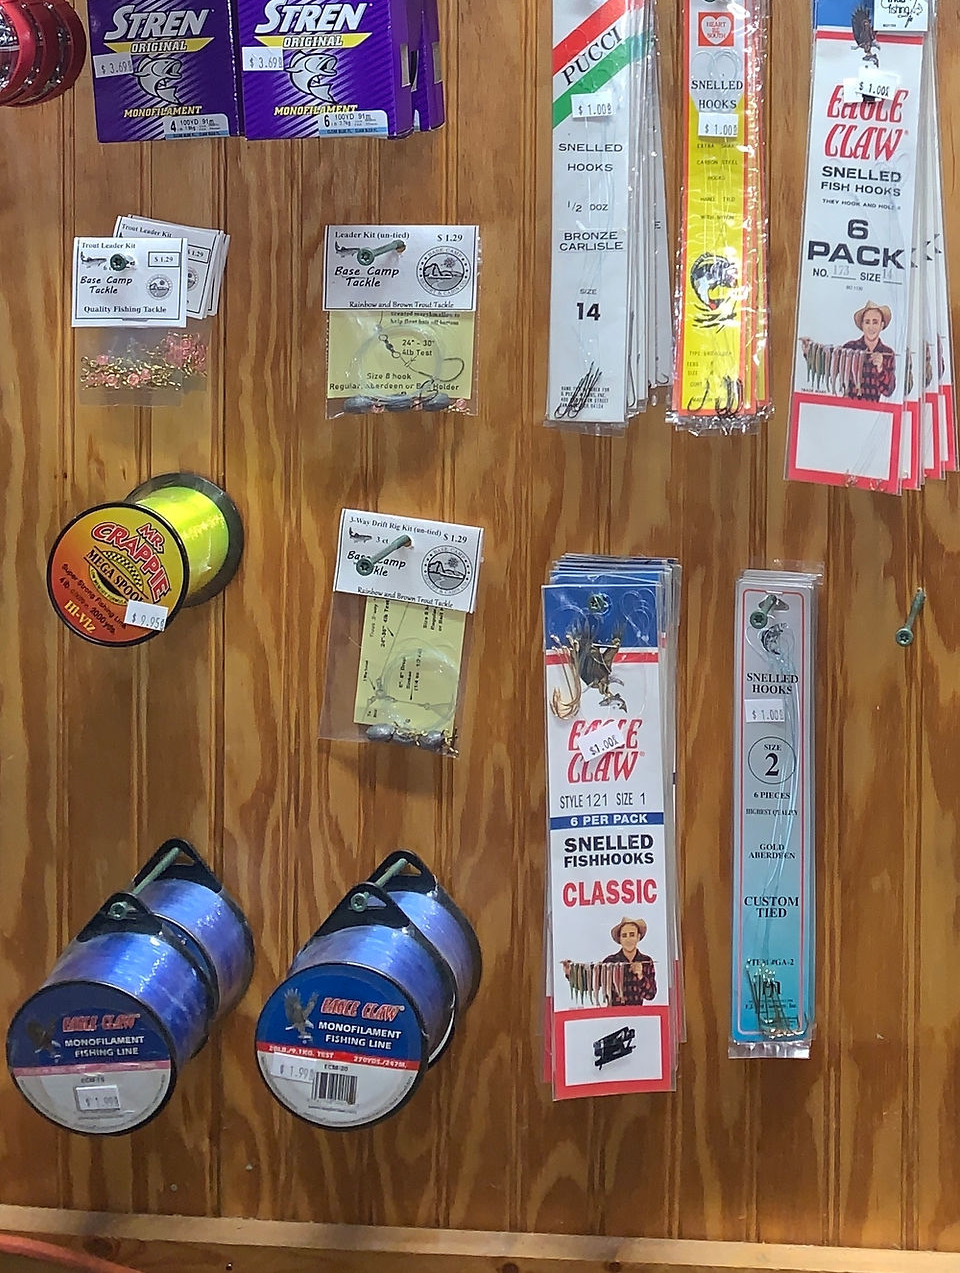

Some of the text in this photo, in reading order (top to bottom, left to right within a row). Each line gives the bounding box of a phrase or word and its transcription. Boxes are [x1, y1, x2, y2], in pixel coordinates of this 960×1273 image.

[282, 35, 343, 49] ORIGINAL
[560, 27, 624, 86] PUCCI
[558, 143, 623, 153] SNELLED
[824, 127, 902, 160] CLAW
[567, 162, 614, 172] HOOKS
[822, 166, 902, 182] SNELLED
[820, 182, 901, 197] FISH HOOKS
[335, 231, 361, 239] Leader
[362, 231, 374, 239] Kit
[563, 230, 618, 241] BRONZE
[846, 218, 869, 240] 6
[445, 234, 463, 242] 1.29
[559, 240, 624, 251] CARLISLE
[807, 241, 905, 269] PACK
[334, 266, 399, 279] Base Camp
[860, 272, 882, 283] SIZE
[345, 277, 381, 287] Tackle
[84, 306, 111, 314] Quality
[112, 306, 140, 314] Fishing
[575, 303, 601, 321] 14
[90, 521, 172, 605] CRAPPIE
[86, 549, 144, 602] MEGA SPOO
[746, 672, 799, 684] SNELLED
[751, 684, 793, 695] HOOKS
[567, 752, 638, 784] CLAW
[764, 754, 780, 778] 2
[560, 792, 633, 809] STYLE 121 SIZE
[570, 814, 648, 826] 6 PER PACK
[563, 835, 655, 852] SNELLED
[563, 851, 655, 867] FISHHOOKS
[561, 879, 658, 908] CLASSIC
[744, 896, 800, 908] CUSTOM
[756, 908, 787, 919] TIED
[320, 997, 401, 1020] EAGLE CLAW
[318, 1020, 401, 1039] MONOFILAMENT
[325, 1033, 392, 1050] FISHING LINE
